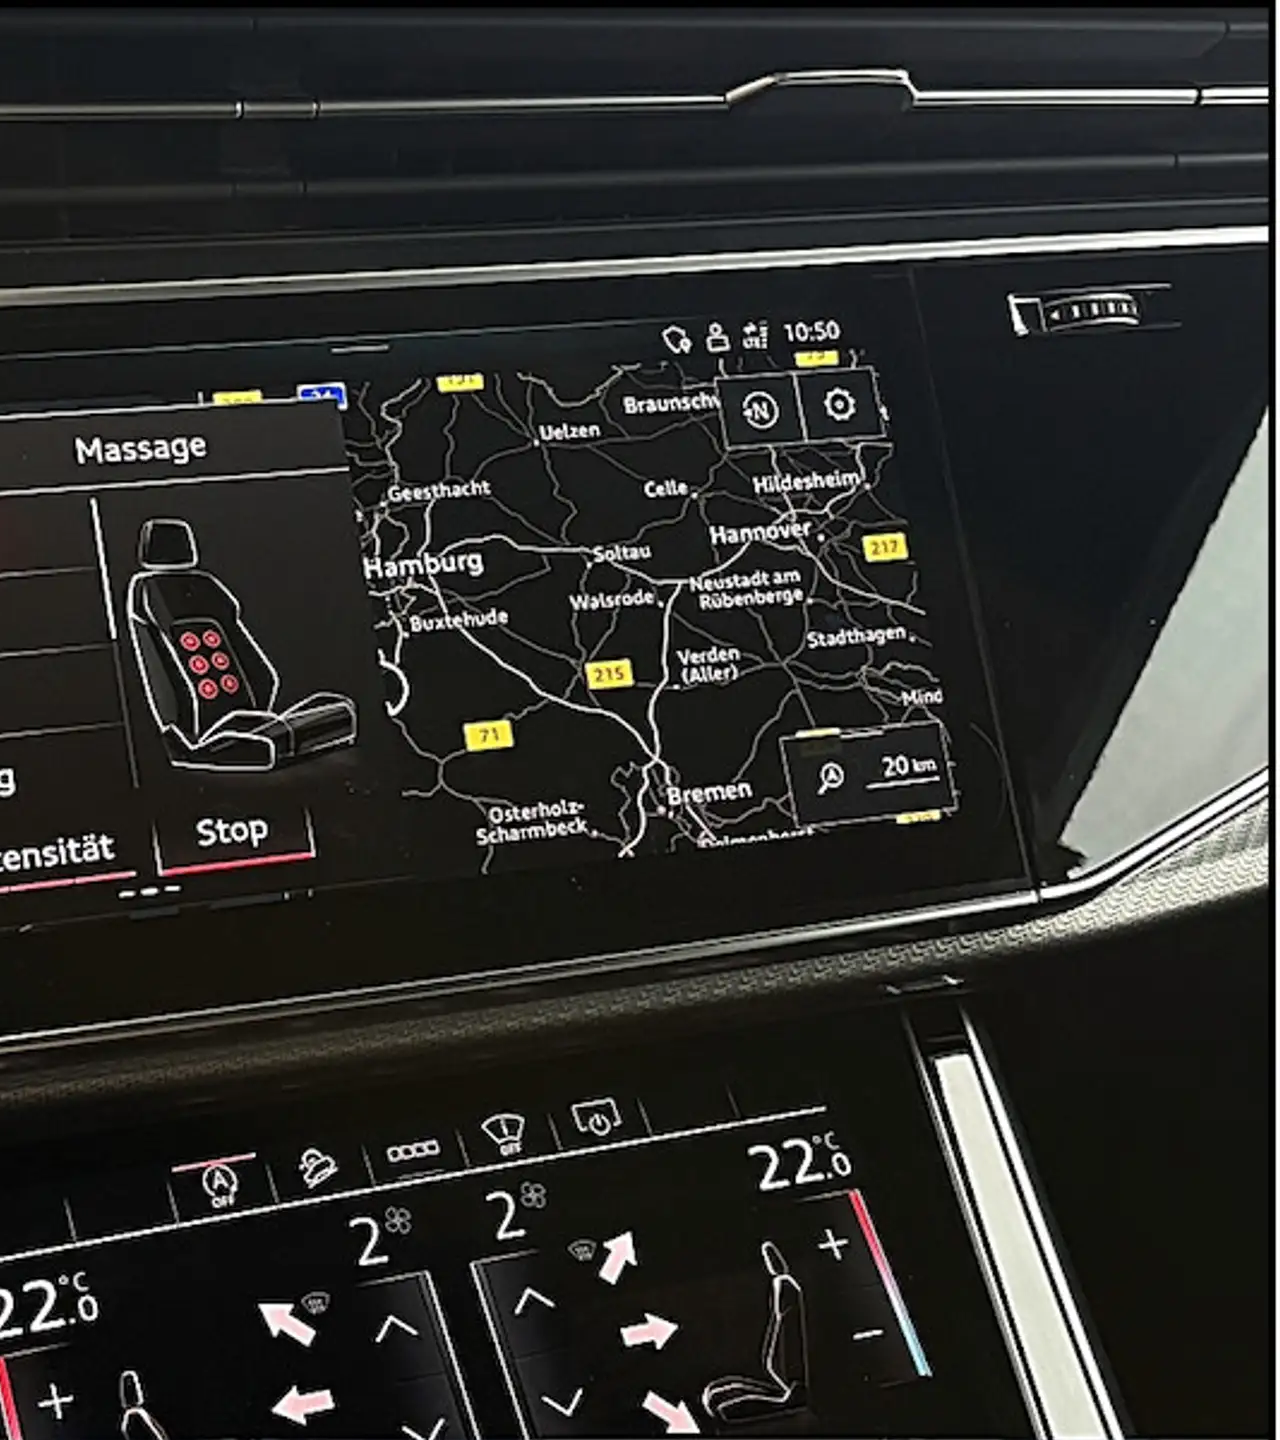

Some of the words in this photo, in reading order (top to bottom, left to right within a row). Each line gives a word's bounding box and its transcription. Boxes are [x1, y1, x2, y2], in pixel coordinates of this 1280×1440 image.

[784, 320, 841, 342] 10:50
[539, 423, 601, 440] Uelzen
[75, 436, 207, 464] Massage
[387, 480, 492, 503] Geesthacht
[644, 480, 689, 498] Celle
[752, 470, 861, 494] Hildesheim
[709, 522, 813, 546] Hannover
[592, 544, 653, 564] Soltau
[869, 538, 900, 556] 217
[363, 551, 485, 580] Hamburg
[688, 573, 769, 593] Neustadt
[771, 571, 802, 584] am
[569, 590, 655, 611] Walsrode
[698, 587, 804, 611] Rübenberge
[409, 607, 509, 632] Buxtehude
[806, 626, 906, 650] Stadthagen
[676, 645, 740, 664] Verden
[592, 665, 624, 684] 215
[680, 662, 740, 685] (Aller)
[478, 727, 501, 744] 71
[881, 754, 910, 777] 20
[912, 758, 938, 773] km
[668, 781, 753, 806] Bremen
[488, 801, 586, 825] Osterholz-
[196, 816, 269, 848] Stop
[476, 819, 587, 846] Scharmbeck
[500, 1142, 522, 1155] OFF
[212, 1195, 235, 1208] OFF
[486, 1191, 527, 1241] 2
[349, 1217, 389, 1267] 2
